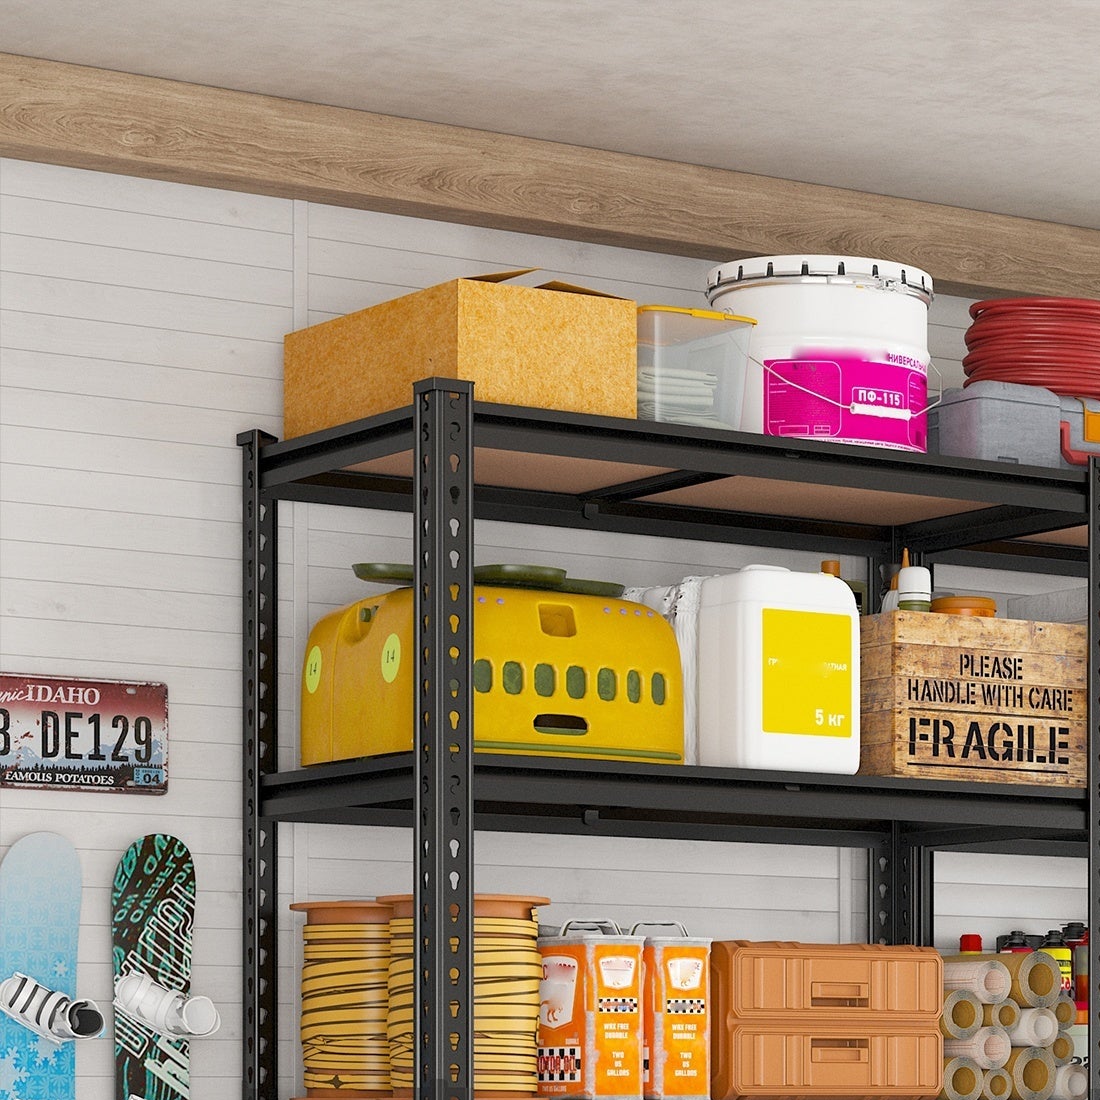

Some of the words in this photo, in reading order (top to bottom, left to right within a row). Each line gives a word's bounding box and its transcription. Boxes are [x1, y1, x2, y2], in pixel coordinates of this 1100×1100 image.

[858, 389, 900, 406] ПФ-115
[959, 653, 1023, 680] PLEASE
[25, 684, 100, 705] IDAHO
[908, 678, 976, 705] HANDLE
[981, 684, 1024, 708] WITH
[1028, 687, 1074, 712] CARE
[815, 708, 824, 726] 5
[41, 710, 152, 763] DE129
[908, 717, 1070, 765] FRAGILE
[5, 771, 52, 782] FAMOUS
[55, 773, 115, 785] POTATOES
[143, 772, 160, 784] 04
